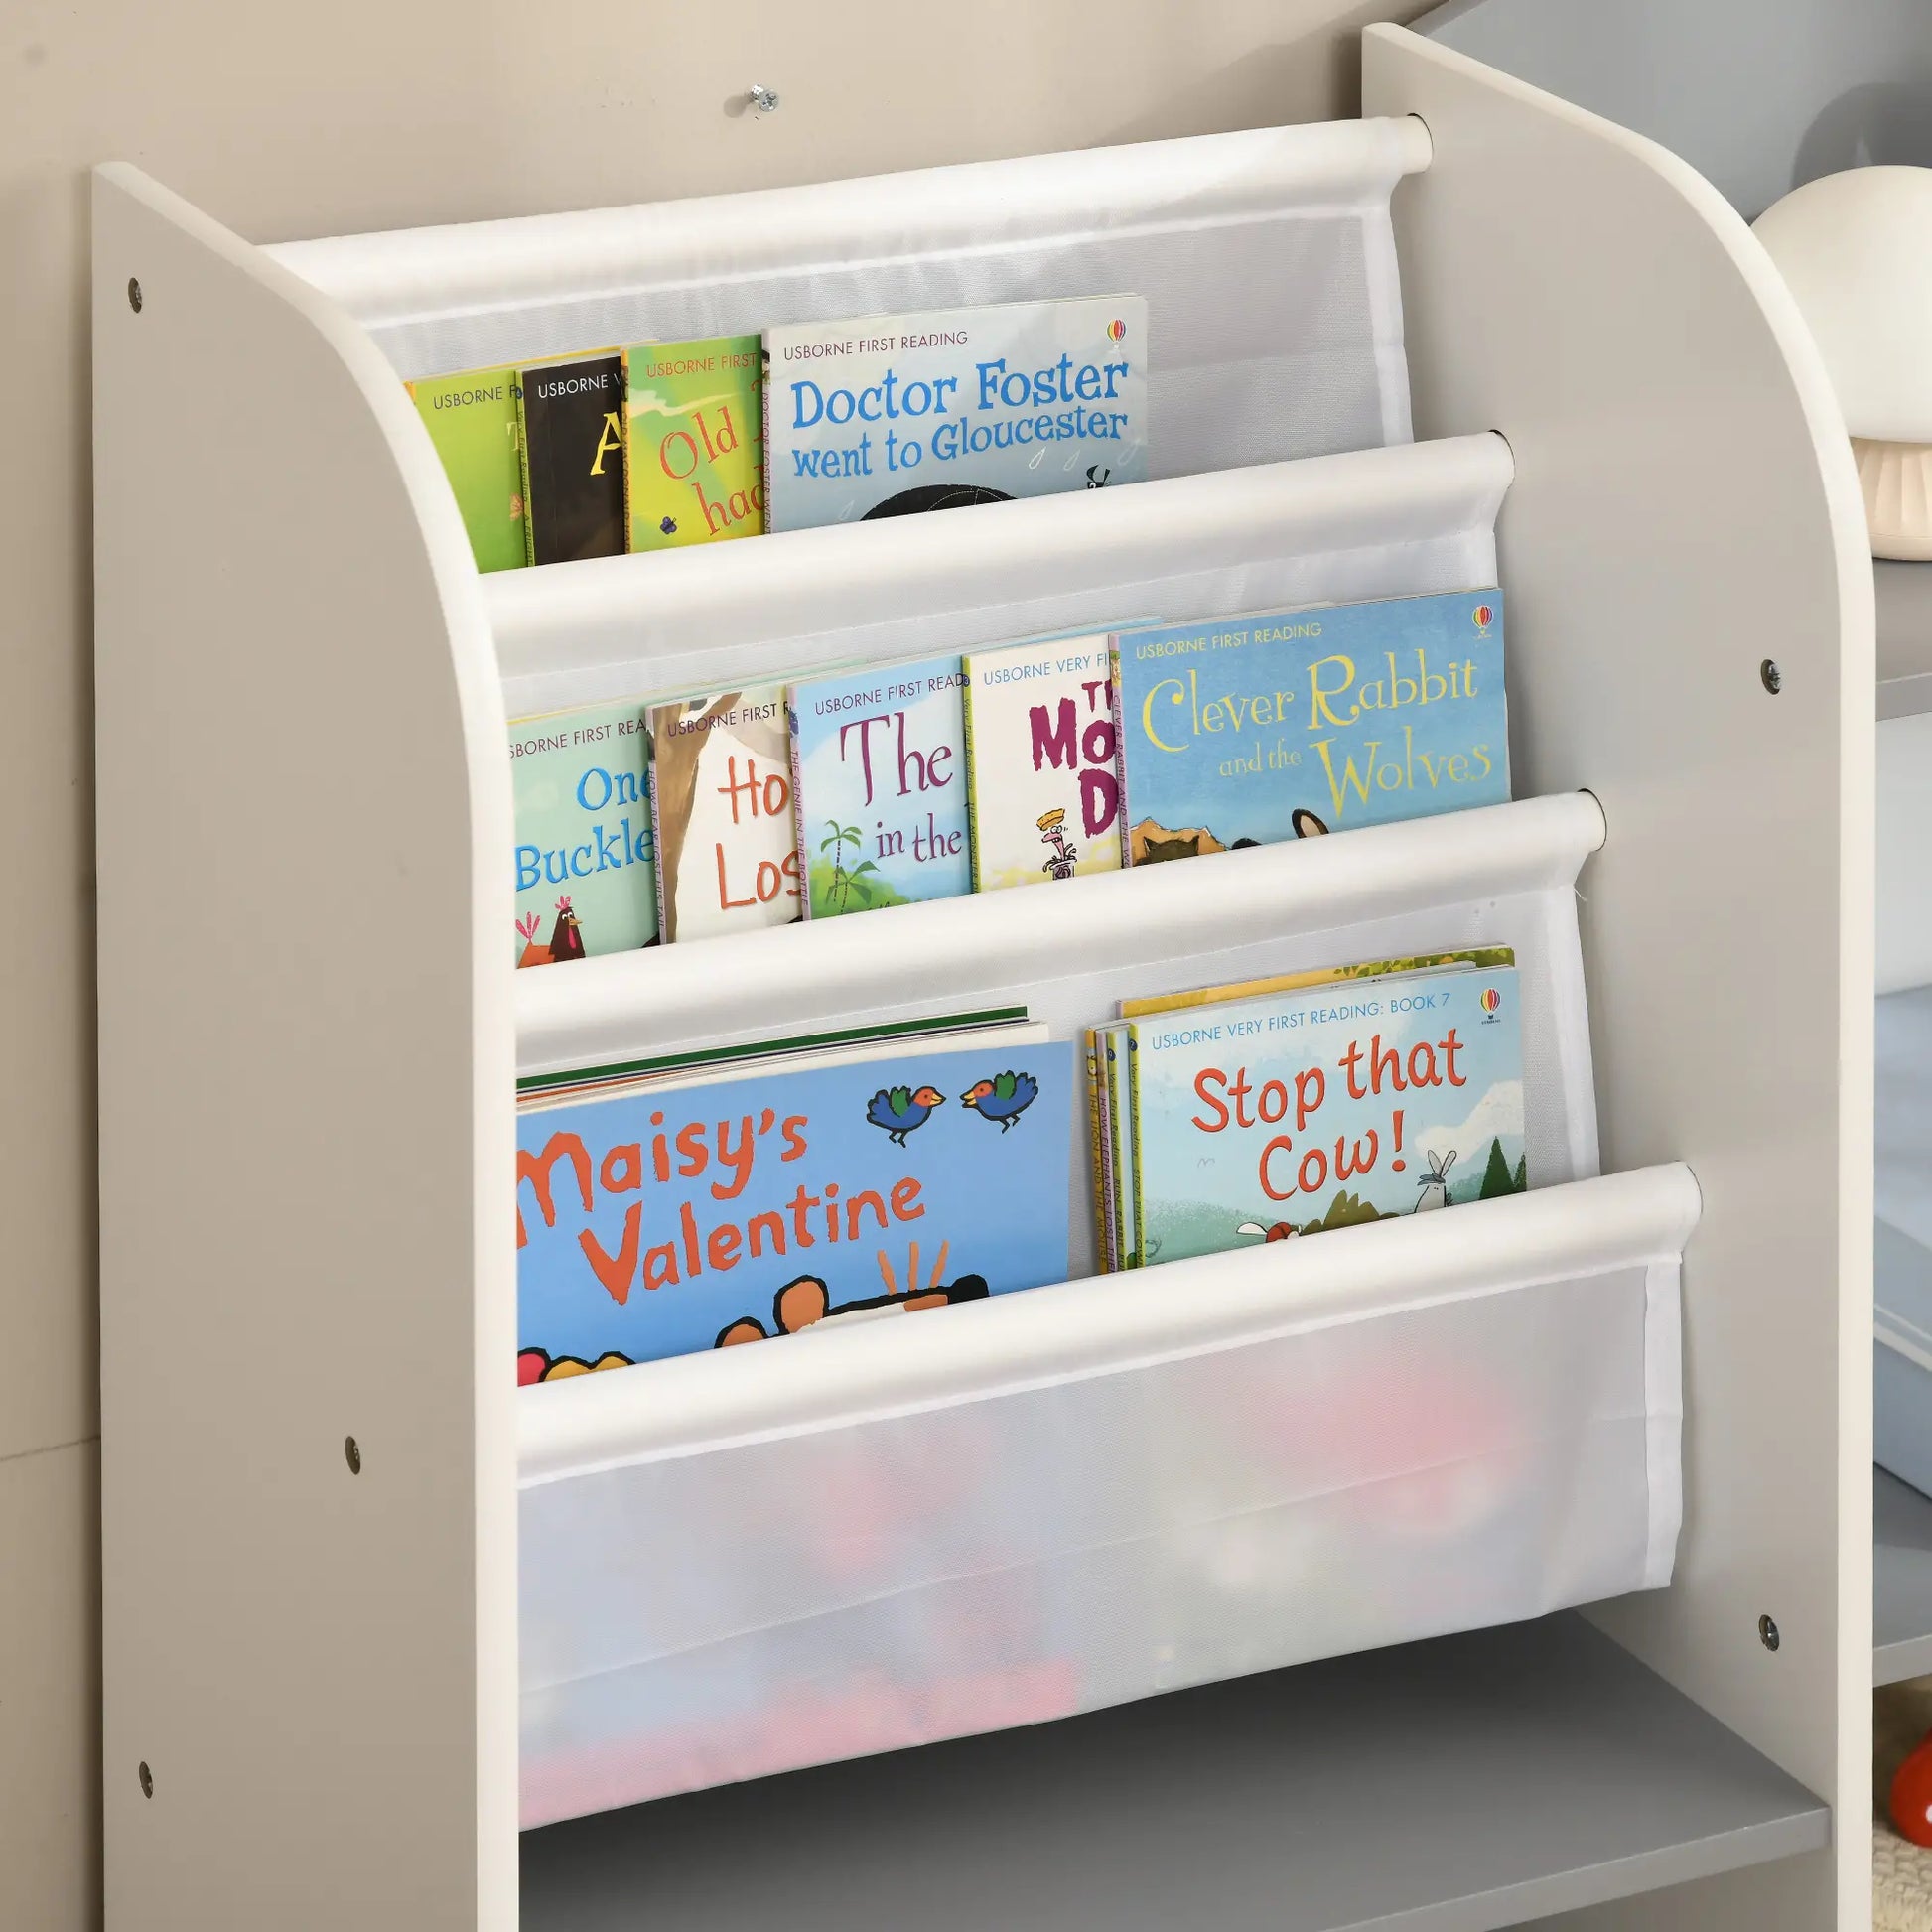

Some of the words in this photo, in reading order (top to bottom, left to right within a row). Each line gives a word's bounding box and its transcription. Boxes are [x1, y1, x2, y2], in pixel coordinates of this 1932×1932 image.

[646, 356, 716, 378] USBORNE
[721, 352, 758, 375] FIRST
[784, 340, 853, 360] USBORNE
[859, 336, 895, 353] FIRST
[900, 331, 968, 349] READING
[433, 386, 503, 410] USBORNE
[538, 374, 609, 399] USBORNE
[790, 369, 958, 429] Doctor
[976, 352, 1129, 410] Foster
[590, 411, 621, 476] A
[659, 406, 739, 481] Old
[792, 429, 873, 479] went
[886, 428, 922, 472] to
[931, 405, 1129, 460] Gloucester
[1136, 636, 1206, 660] USBORNE
[1212, 631, 1249, 649] FIRST
[1255, 622, 1322, 644] READING
[984, 663, 1051, 686] USBORNE
[1056, 655, 1090, 674] VERY
[815, 688, 882, 716] USBORNE
[888, 680, 922, 701] FIRST
[1113, 695, 1122, 737] CLEVER
[1142, 669, 1294, 752] Clever
[1306, 648, 1478, 732] Rabbit
[574, 724, 612, 745] FIRST
[667, 710, 737, 737] USBORNE
[742, 703, 777, 723] FIRST
[791, 750, 800, 772] THE
[840, 711, 953, 807] The
[1116, 743, 1126, 782] RABBIT
[1219, 742, 1261, 777] and
[1269, 738, 1302, 767] the
[1310, 726, 1491, 820] Wolves
[793, 776, 803, 814] GENIE
[1119, 788, 1128, 816] AND
[795, 818, 804, 832] IN
[875, 821, 905, 859] in
[912, 813, 963, 863] the
[1121, 821, 1130, 843] THE
[515, 817, 654, 892] Buckle
[797, 837, 806, 859] THE
[798, 863, 809, 905] BOTTLE
[1152, 1025, 1221, 1050] USBORNE
[1227, 1018, 1263, 1038] VERY
[1268, 1012, 1305, 1032] FIRST
[1311, 1001, 1384, 1025] READING:
[1390, 994, 1436, 1014] BOOK
[1441, 992, 1450, 1008] 7
[1191, 1066, 1325, 1133] Stop
[1337, 1028, 1466, 1100] that
[1132, 1113, 1141, 1156] Reading
[1259, 1109, 1406, 1201] Cow!
[516, 1108, 808, 1251] Maisy's
[1093, 1157, 1103, 1185] AND
[1101, 1136, 1112, 1206] ELEPHANTS
[578, 1176, 925, 1306] Valentine
